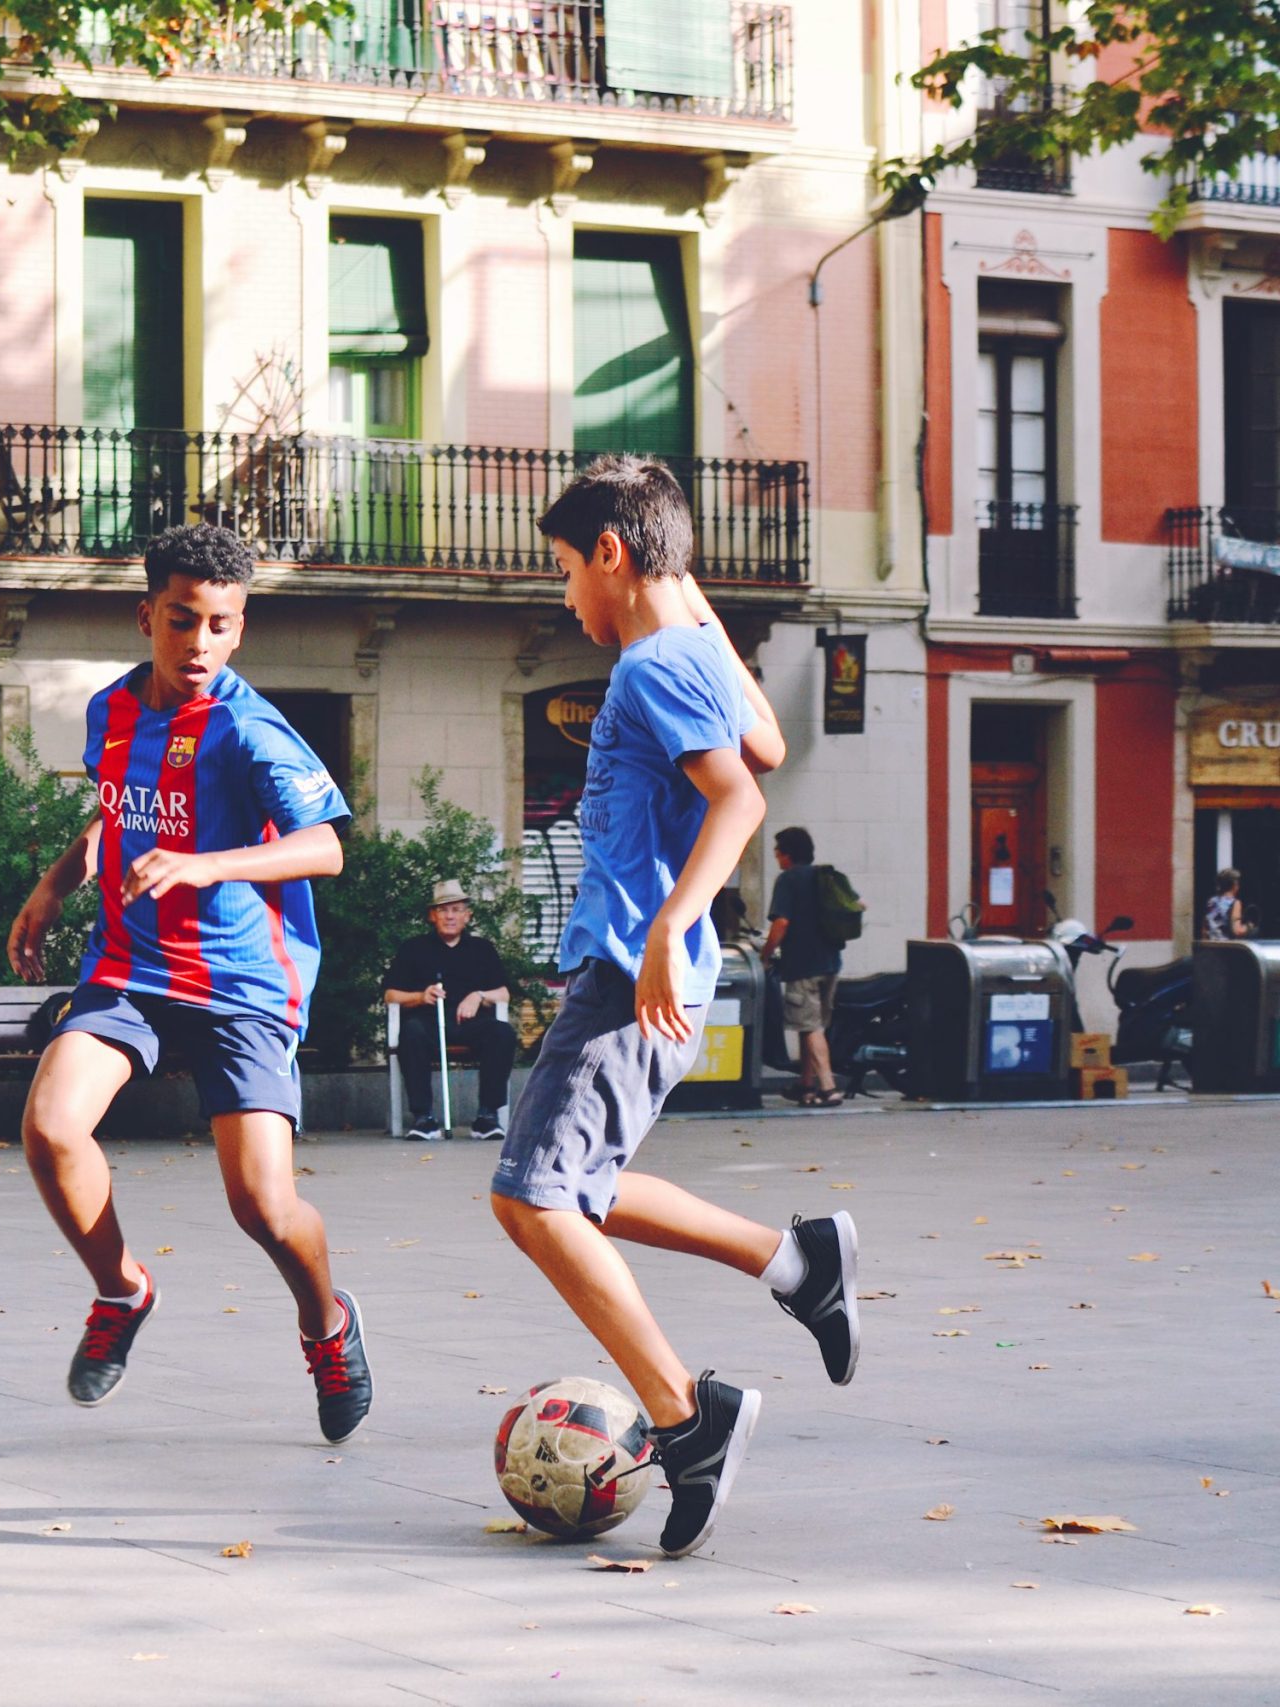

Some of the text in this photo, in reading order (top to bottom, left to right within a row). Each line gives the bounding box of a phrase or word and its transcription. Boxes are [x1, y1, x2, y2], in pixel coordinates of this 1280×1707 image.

[562, 701, 597, 723] the
[100, 781, 189, 818] QATAR
[114, 812, 189, 837] AIRWAYS
